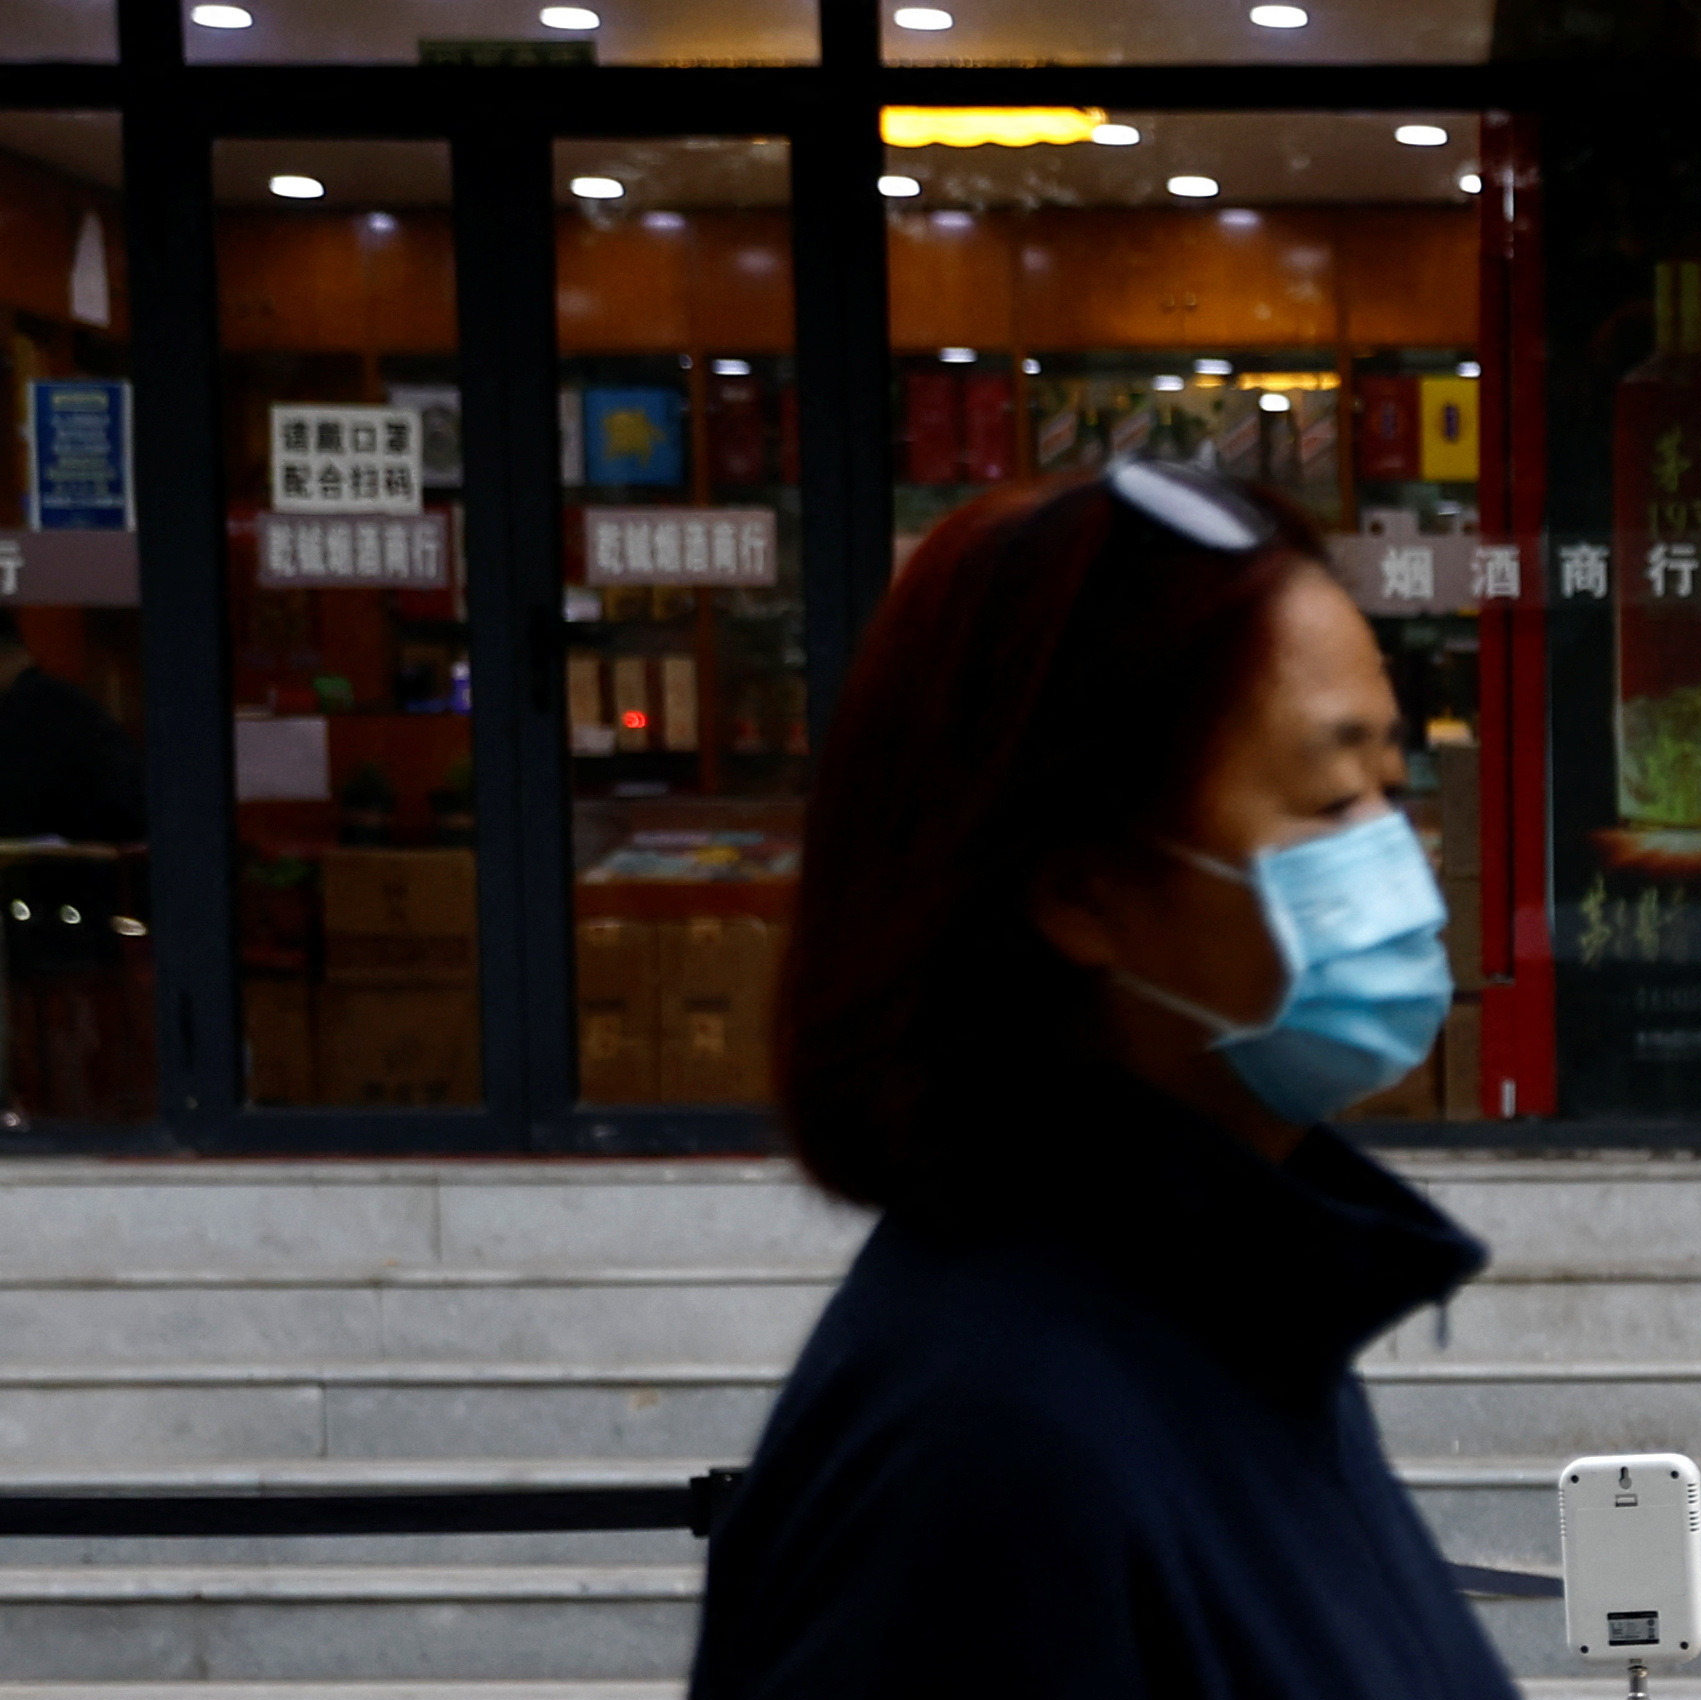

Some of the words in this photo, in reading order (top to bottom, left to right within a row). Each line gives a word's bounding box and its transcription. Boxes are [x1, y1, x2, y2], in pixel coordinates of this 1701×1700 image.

[283, 417, 409, 455] 请戴口罩
[282, 461, 413, 499] 配合扫码
[1381, 543, 1701, 601] 烟酒商行
